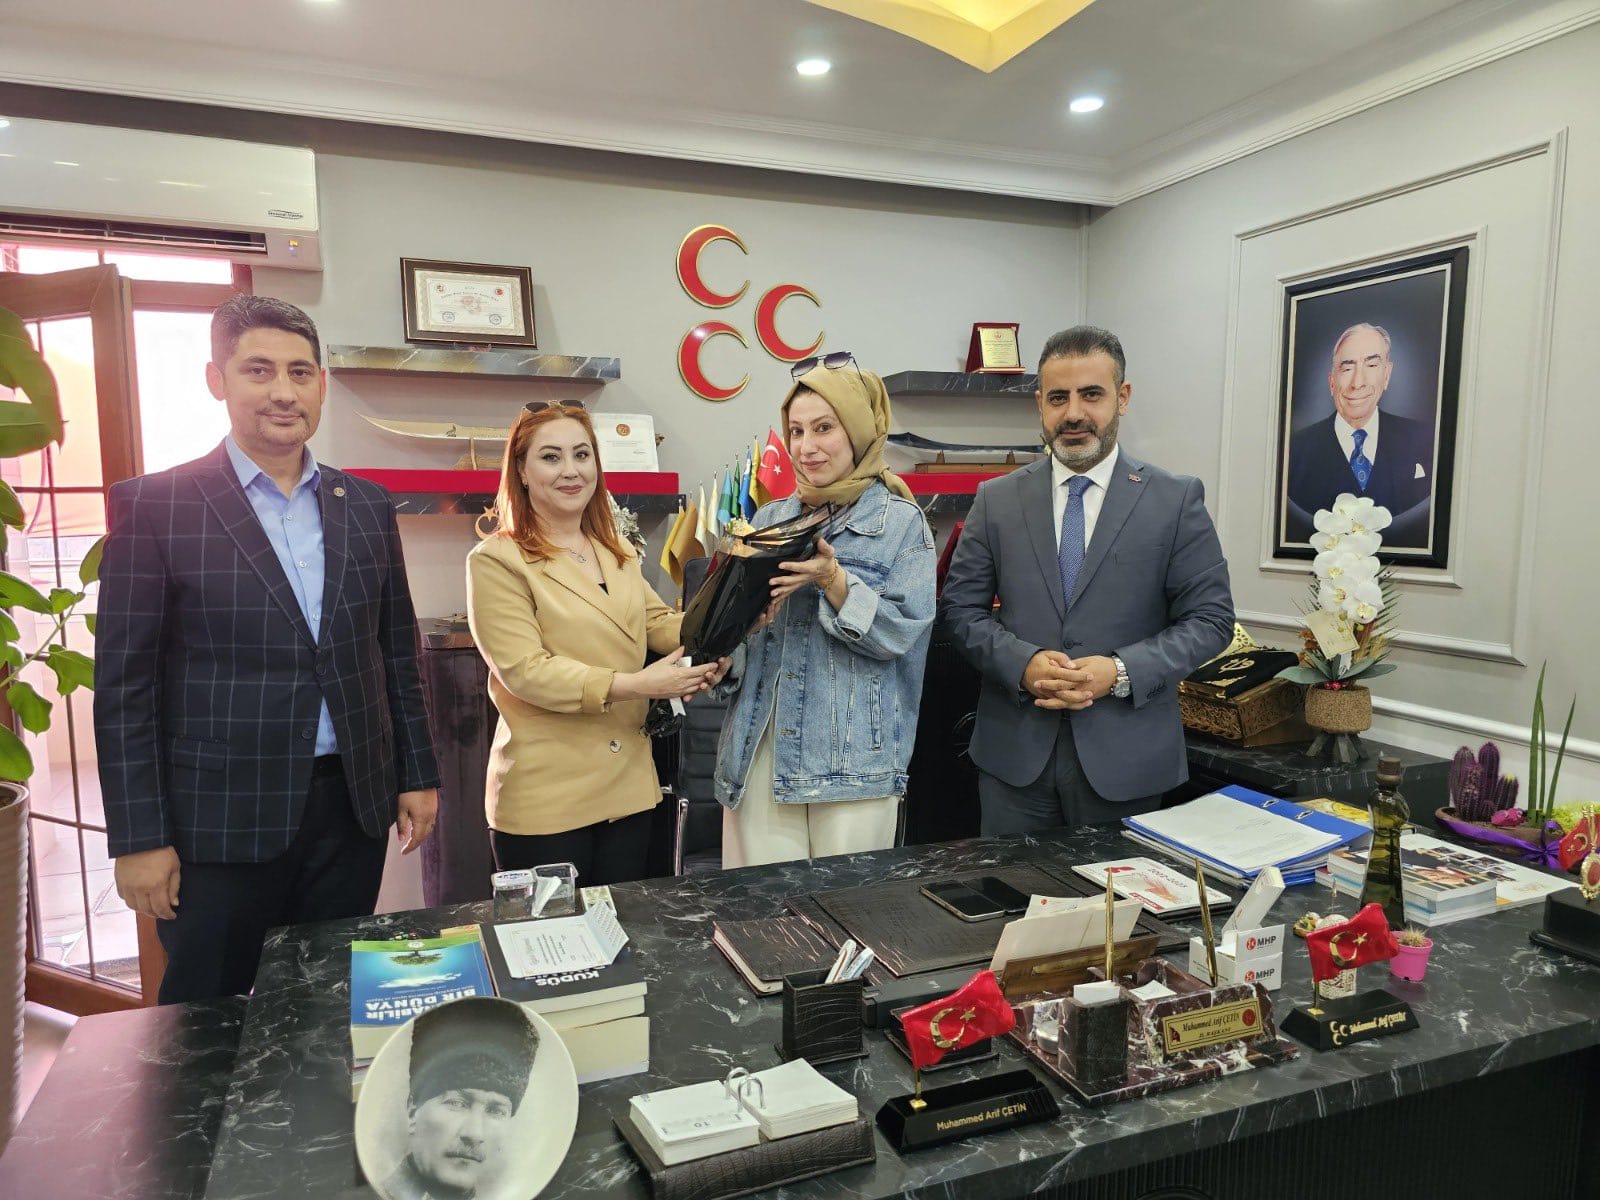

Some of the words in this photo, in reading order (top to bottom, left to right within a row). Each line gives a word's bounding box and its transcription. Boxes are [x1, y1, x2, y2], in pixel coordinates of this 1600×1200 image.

[1256, 935, 1277, 947] MHP
[535, 970, 600, 986] KUDÜS
[1255, 968, 1275, 979] MHP
[365, 995, 437, 1011] DÜNYA
[936, 1112, 984, 1131] Muhammed
[985, 1107, 1001, 1120] Arif
[1001, 1102, 1027, 1118] ÇETİN
